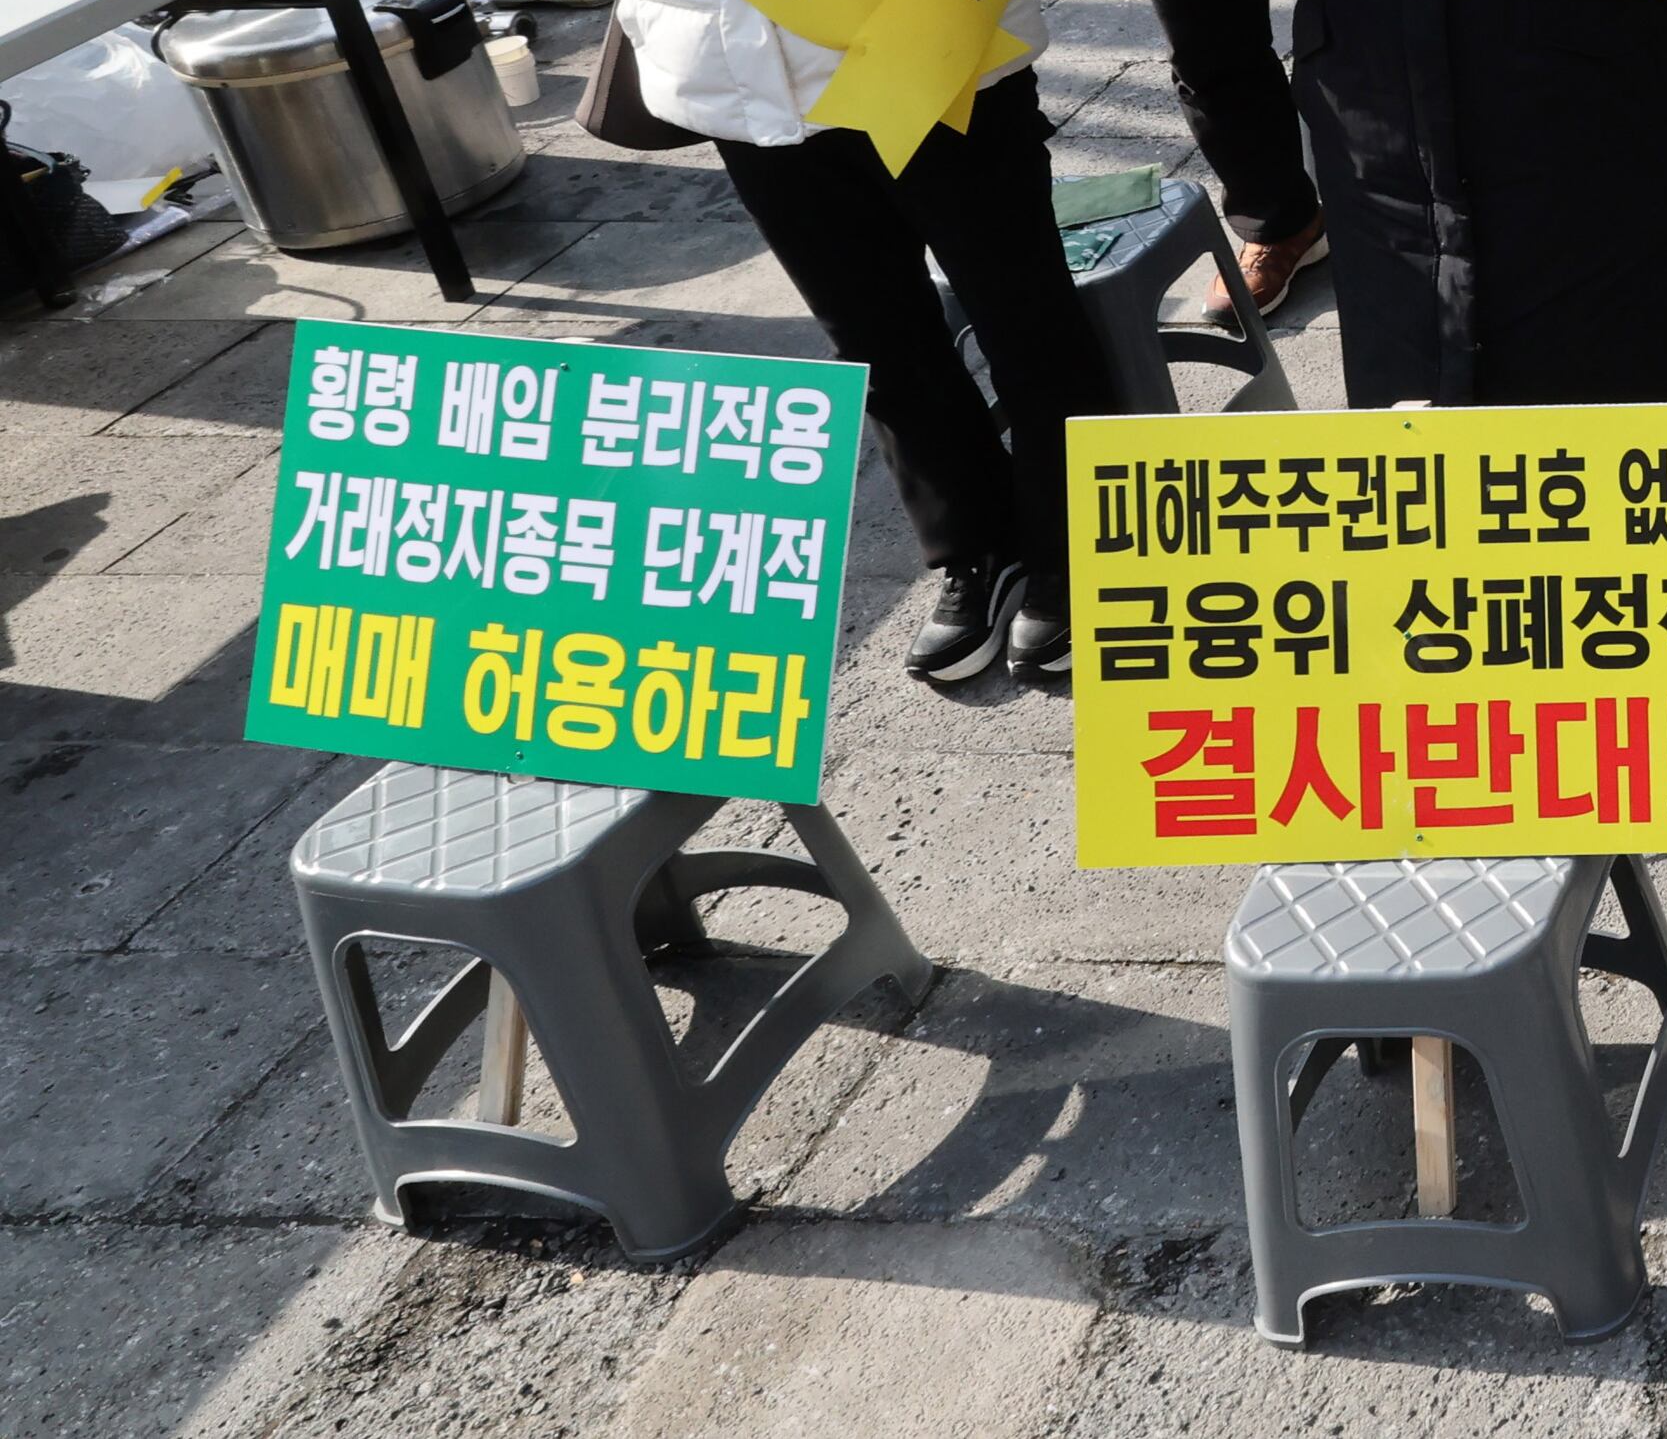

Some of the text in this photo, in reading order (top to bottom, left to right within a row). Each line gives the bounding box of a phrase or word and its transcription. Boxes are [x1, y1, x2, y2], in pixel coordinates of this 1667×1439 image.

[307, 345, 833, 486] 횡령 배임 분리적용
[284, 471, 826, 621] 거래정지종목 단계적
[1093, 452, 1447, 558] 피해주주권리
[1477, 447, 1591, 545] 보호
[268, 603, 811, 770] 매매 허용하라
[1093, 579, 1351, 681] 금융위
